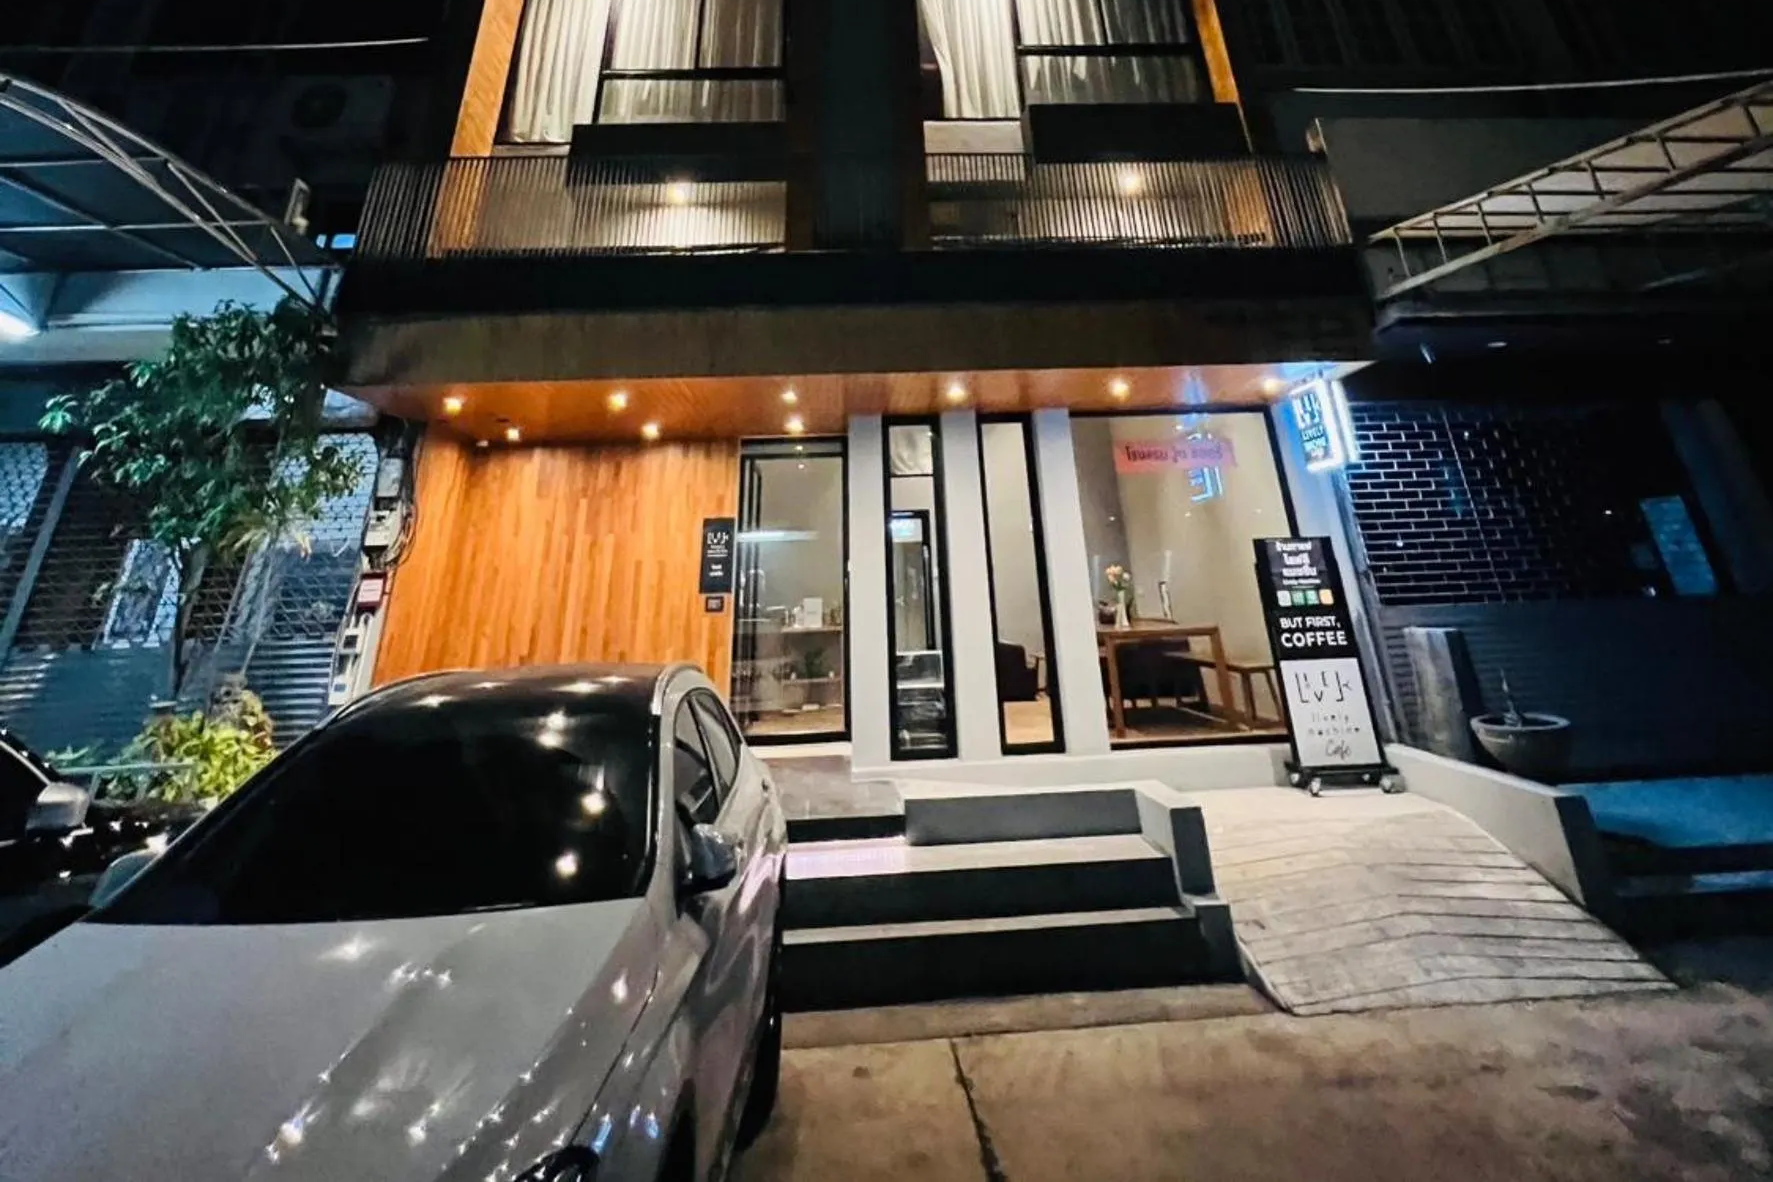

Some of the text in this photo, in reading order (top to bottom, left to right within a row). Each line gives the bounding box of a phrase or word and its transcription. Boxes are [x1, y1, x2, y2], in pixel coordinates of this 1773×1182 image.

[1280, 615, 1341, 629] BUT FIRST,
[1280, 630, 1348, 648] COFFEE
